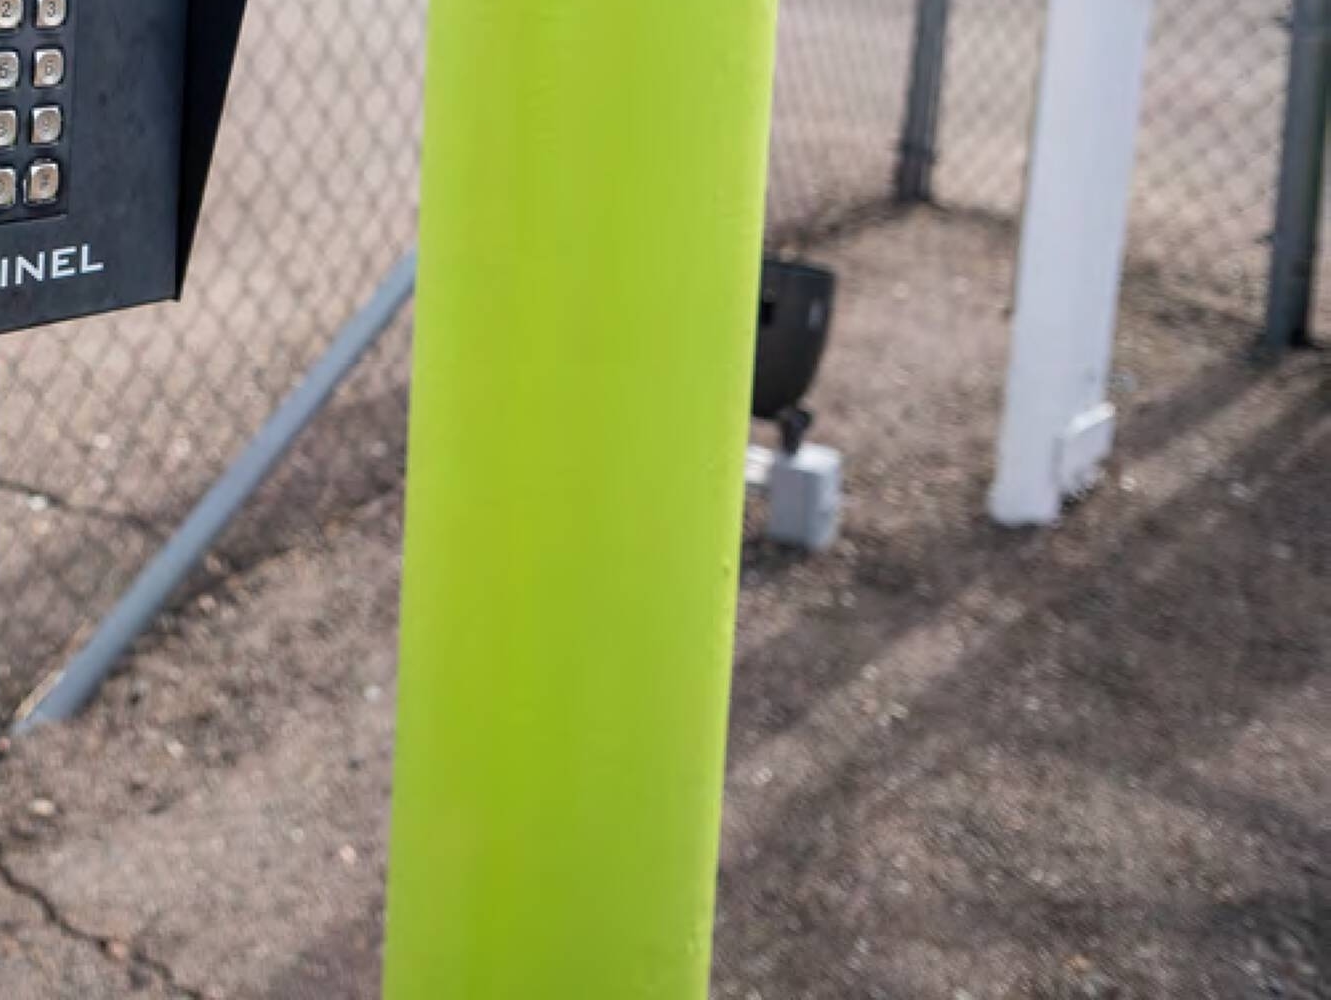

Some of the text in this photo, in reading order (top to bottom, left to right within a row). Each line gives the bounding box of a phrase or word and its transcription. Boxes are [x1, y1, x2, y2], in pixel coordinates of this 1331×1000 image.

[1, 1, 12, 18] 2
[46, 1, 56, 18] 3
[44, 59, 55, 76] 6
